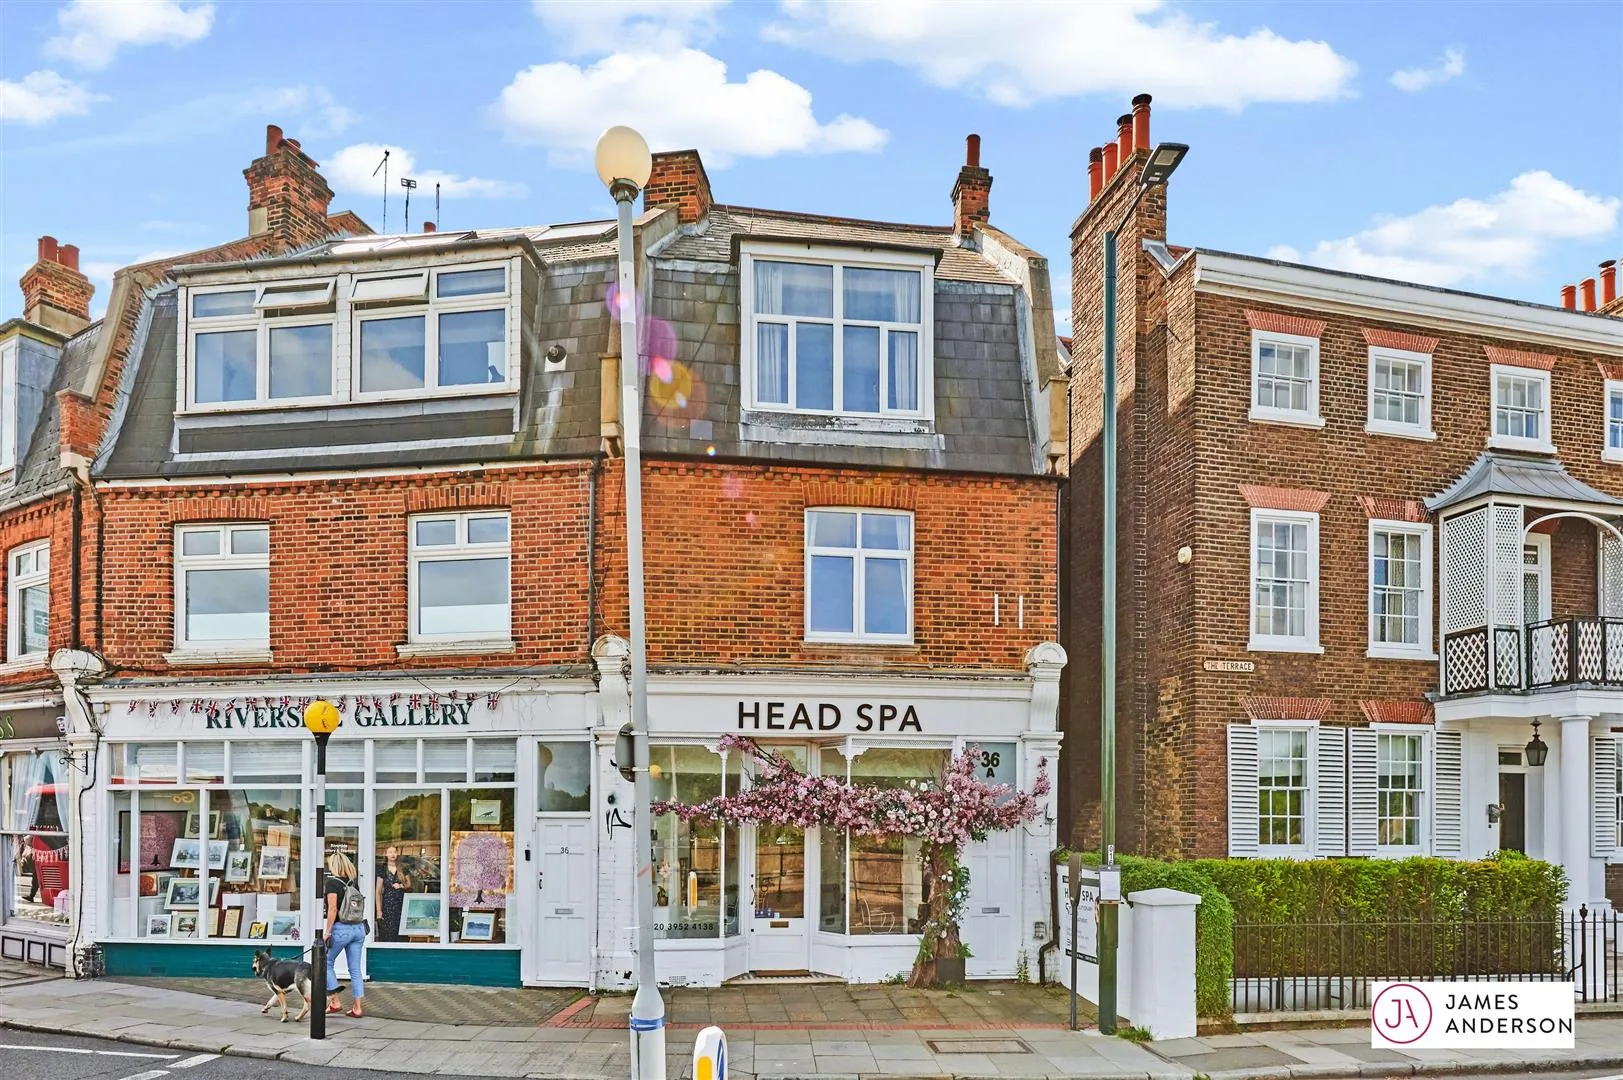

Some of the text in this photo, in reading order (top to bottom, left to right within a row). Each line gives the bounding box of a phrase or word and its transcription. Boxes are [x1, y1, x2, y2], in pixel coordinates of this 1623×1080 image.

[1207, 661, 1252, 671] THE TERRACE
[354, 703, 473, 727] GALLERY
[738, 701, 922, 732] HEAD SPA
[981, 751, 1000, 768] 36
[986, 767, 995, 778] A
[560, 846, 570, 855] 36
[1082, 890, 1094, 902] SPA
[667, 923, 689, 931] 3952
[692, 923, 714, 931] 4138
